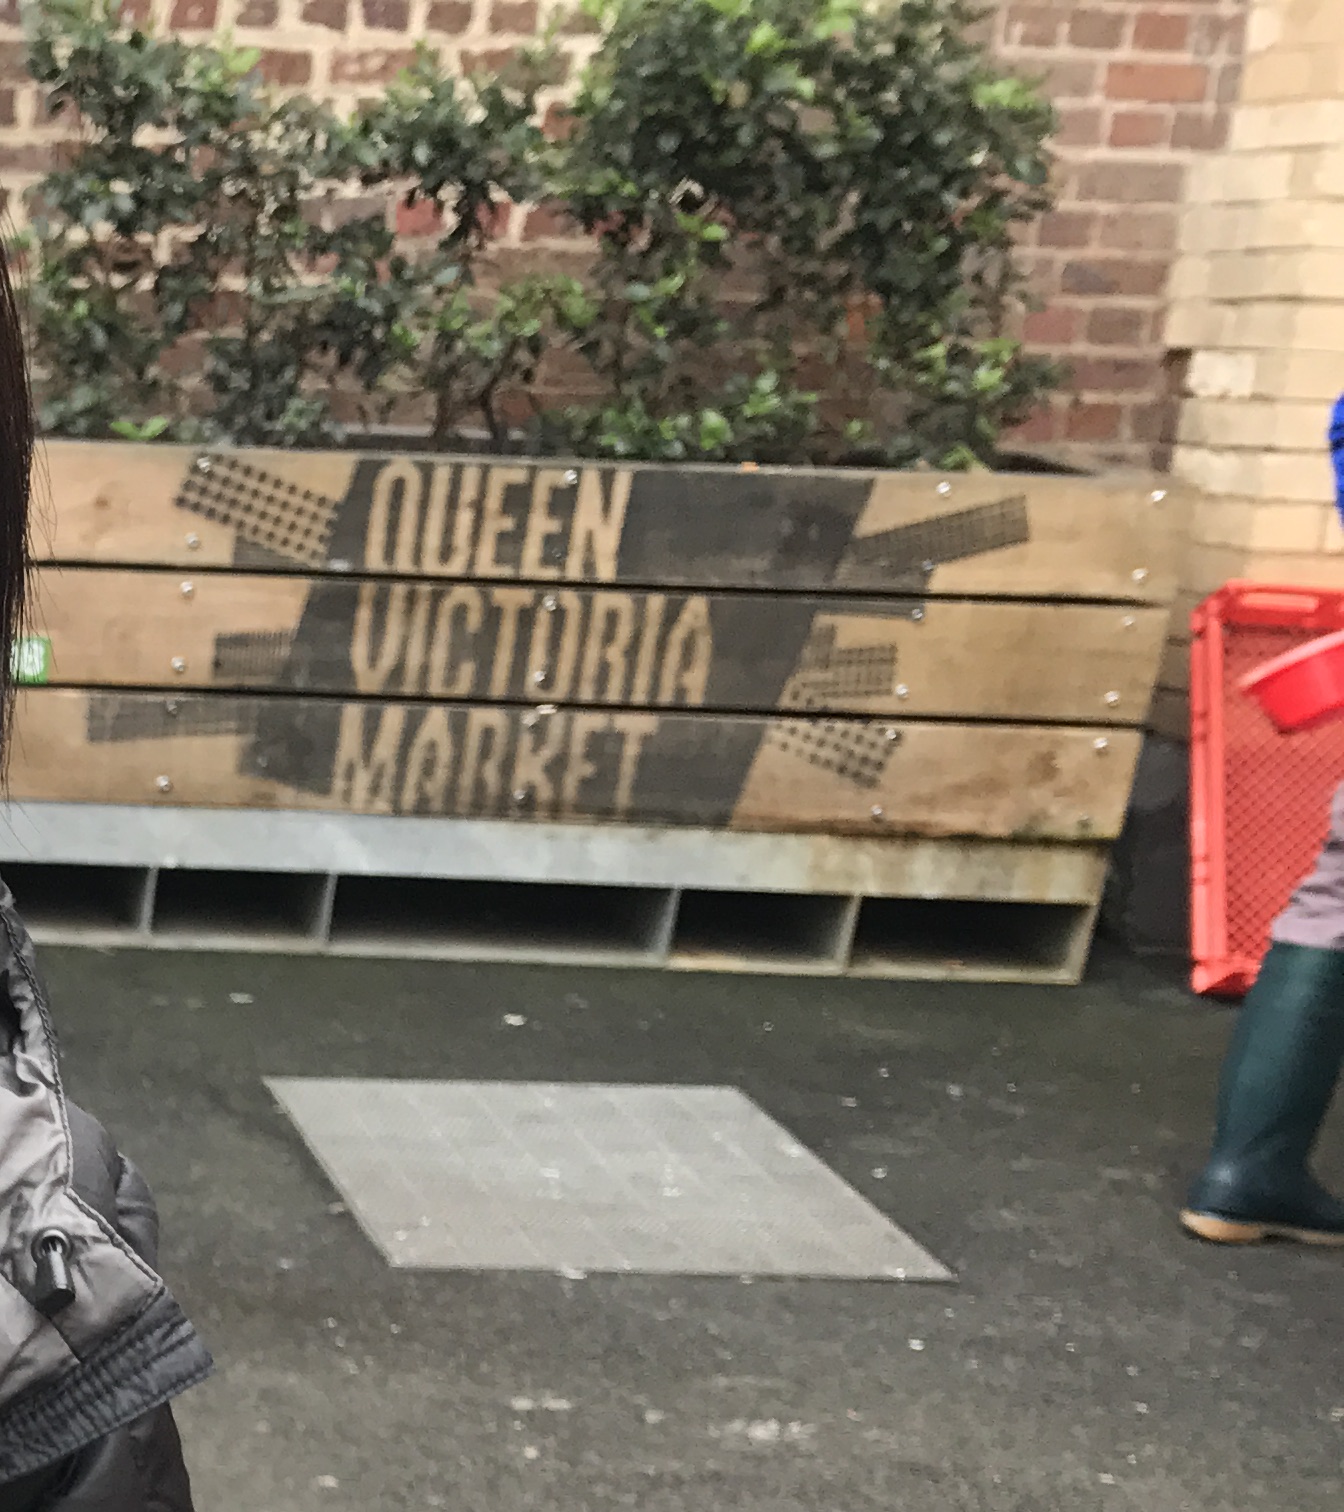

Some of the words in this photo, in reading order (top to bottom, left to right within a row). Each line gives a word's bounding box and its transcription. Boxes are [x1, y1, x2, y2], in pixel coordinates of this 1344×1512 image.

[364, 459, 633, 582] QUEEN
[350, 583, 712, 706] VICTORIA
[332, 704, 659, 816] MARKET
